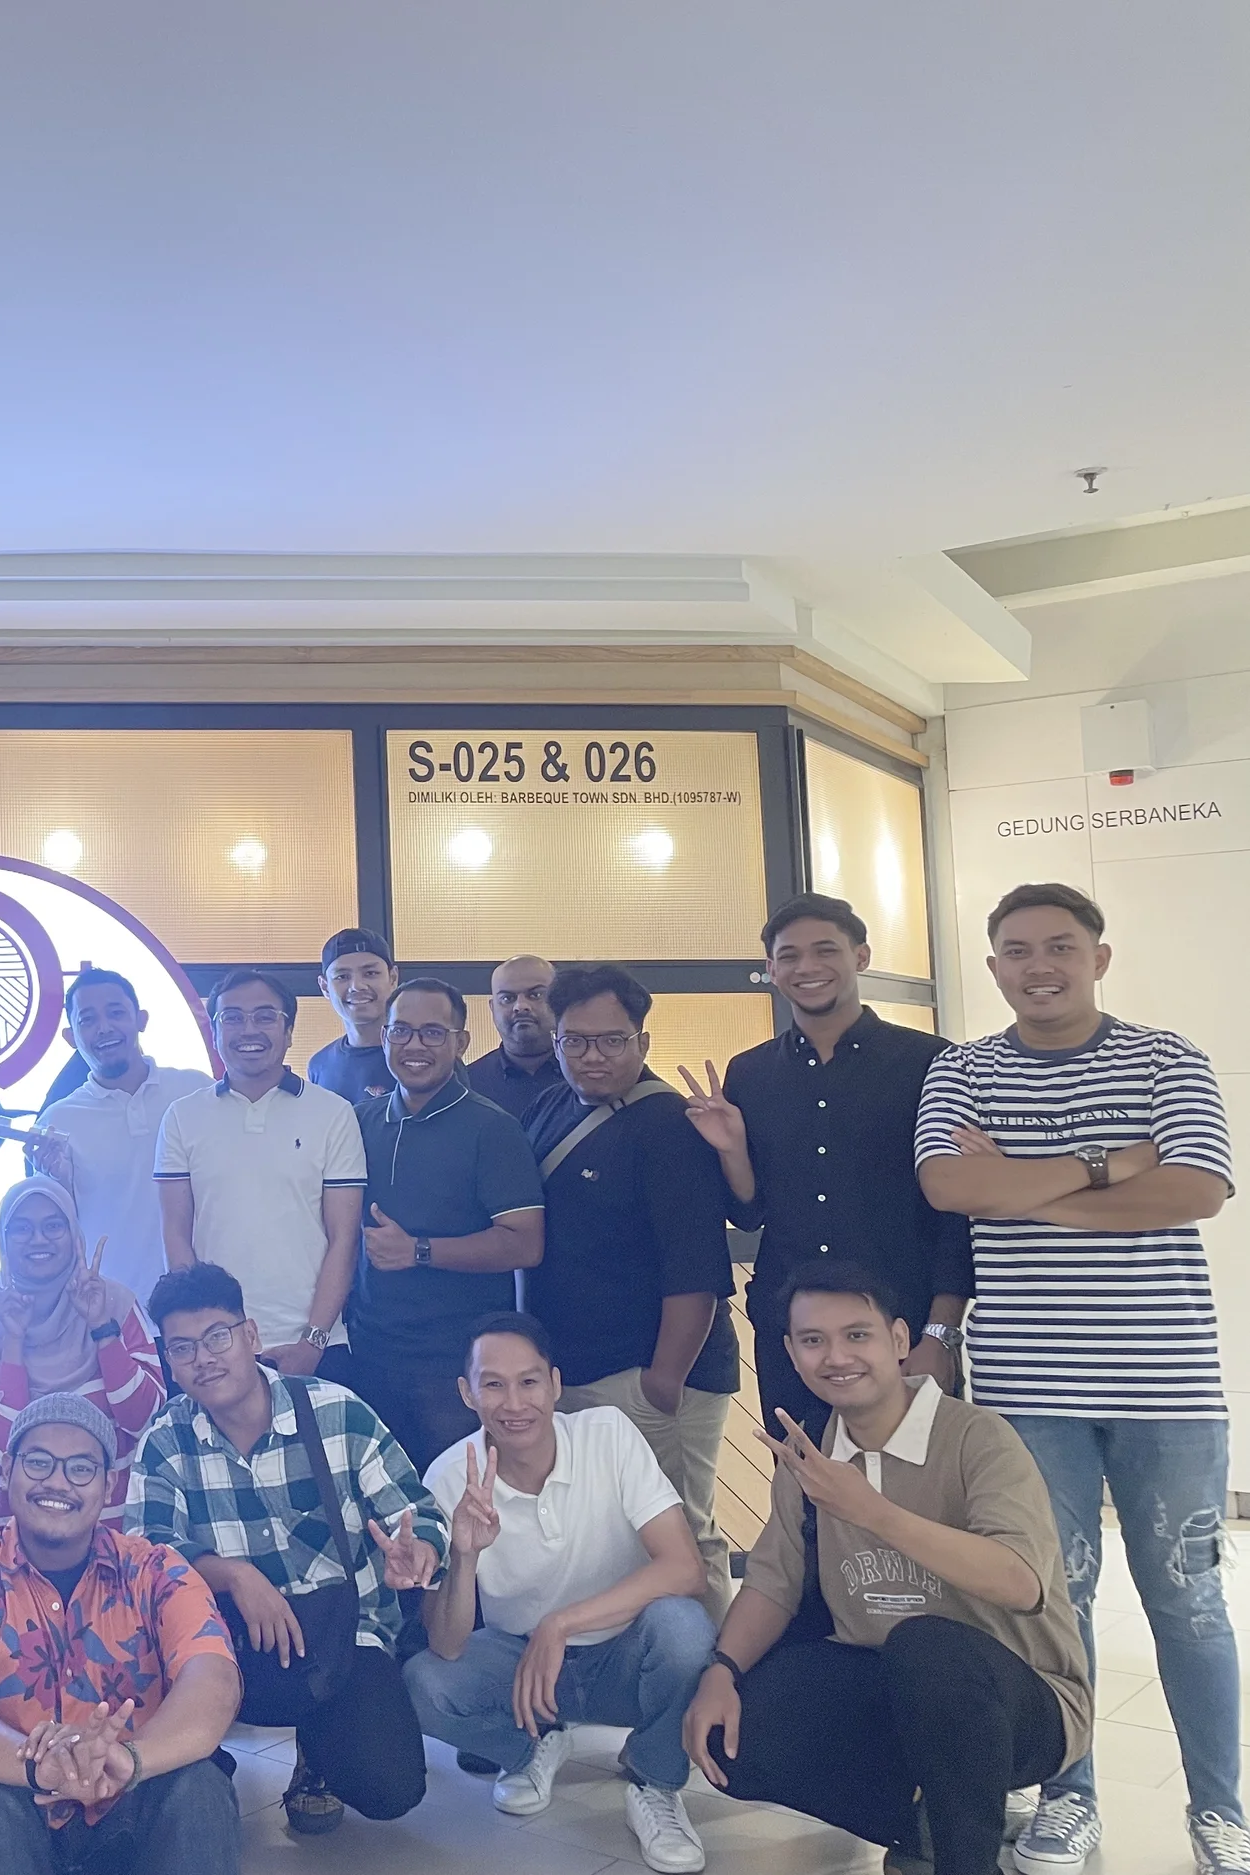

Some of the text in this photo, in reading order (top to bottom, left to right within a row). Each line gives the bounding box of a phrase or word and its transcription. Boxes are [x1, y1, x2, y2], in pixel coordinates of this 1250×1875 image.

[408, 739, 656, 783] S-025 & 026
[408, 791, 457, 804] DIMILIKI
[459, 792, 498, 804] OLEH:
[500, 792, 569, 805] BARBEQUE
[572, 792, 609, 804] TOWN
[612, 792, 641, 804] SDN.
[996, 801, 1222, 838] GEDUNG SERBANEKA
